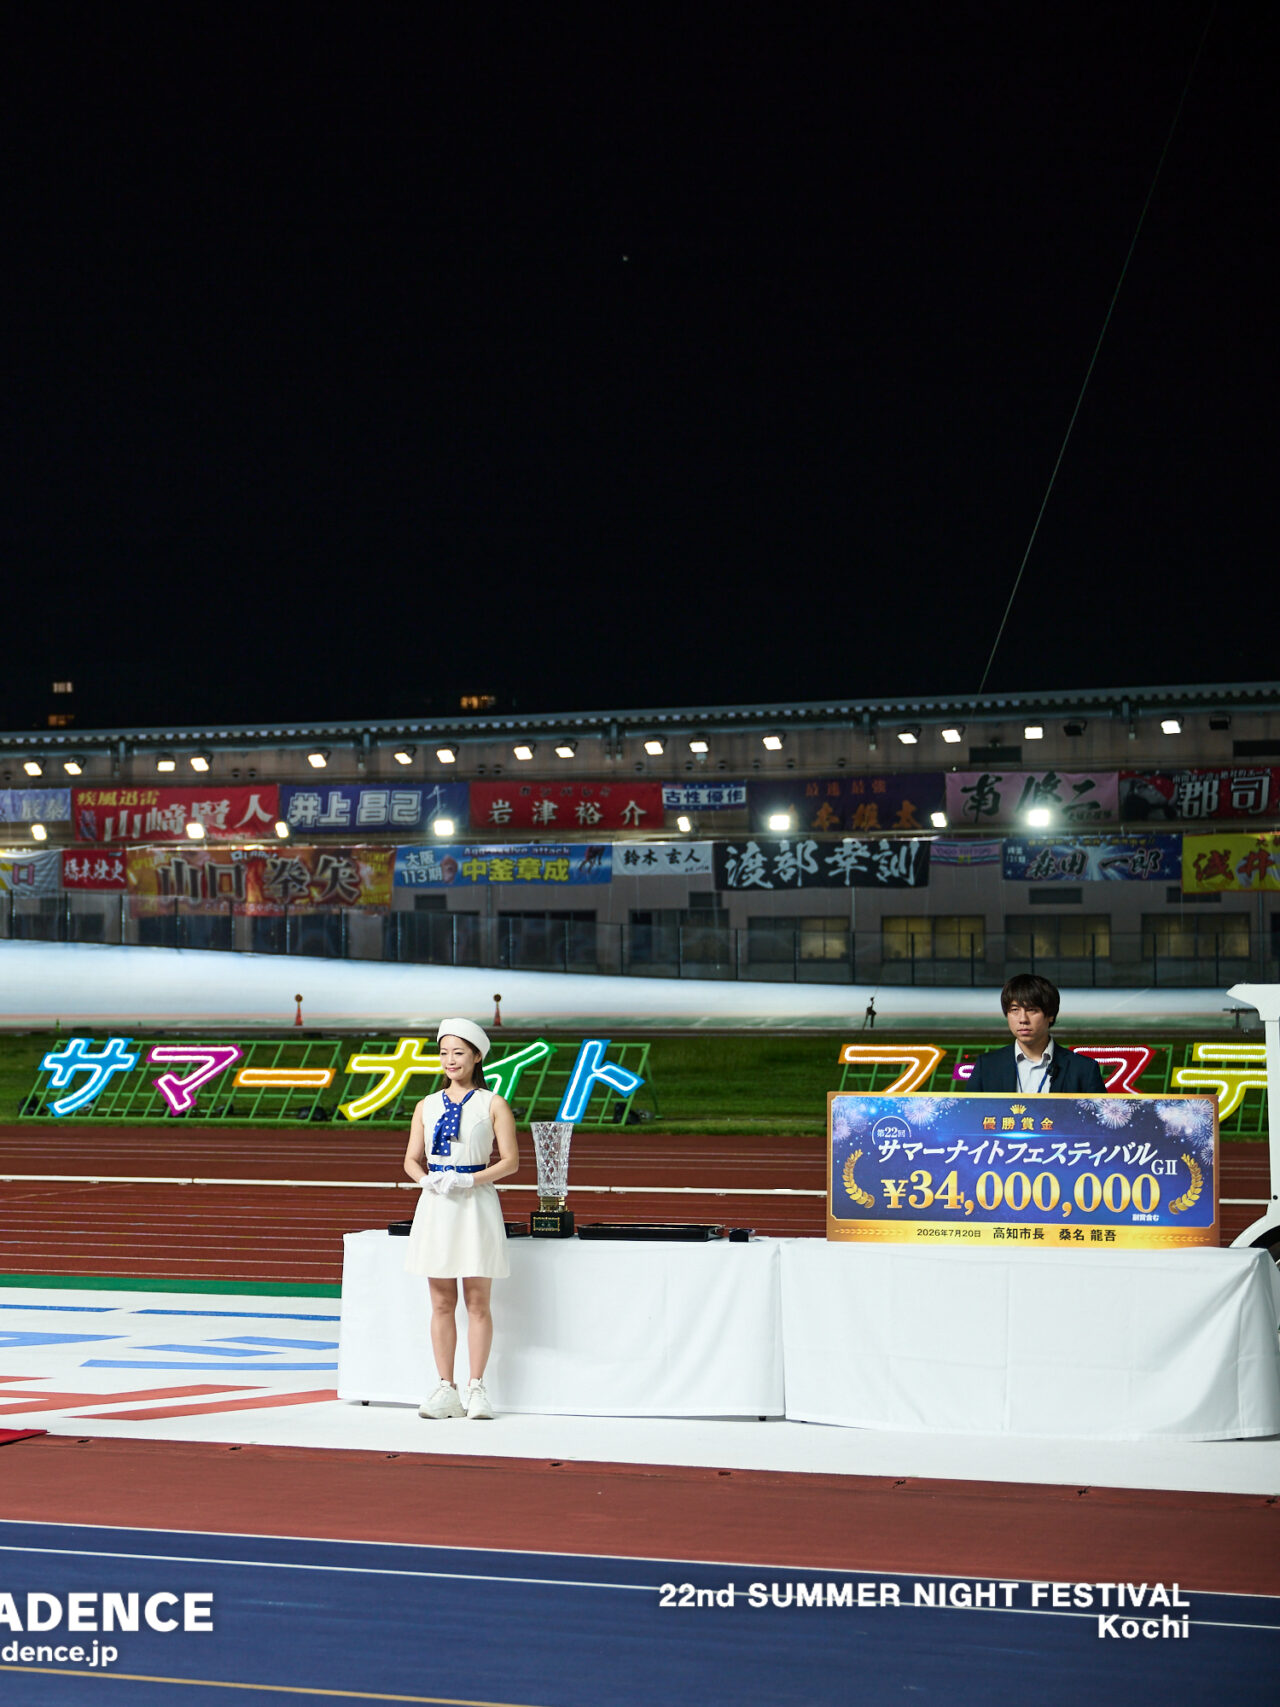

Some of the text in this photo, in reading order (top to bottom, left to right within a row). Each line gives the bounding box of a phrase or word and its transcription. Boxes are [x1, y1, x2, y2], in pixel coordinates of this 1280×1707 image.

[77, 789, 159, 806] 疾風迅雷
[287, 789, 422, 828] 井上昌己
[664, 789, 743, 804] 古性優作
[1177, 776, 1271, 818] 郡司
[488, 798, 647, 827] 岩津裕介
[405, 850, 434, 867] 大阪
[463, 845, 570, 856] Aggressive attack
[624, 848, 700, 866] 鈴木 玄人
[402, 866, 443, 884] 113期
[462, 857, 570, 882] 中釜章成
[724, 838, 920, 889] 渡部幸訓
[157, 854, 361, 905] 山口拳矢
[38, 1038, 645, 1122] サマーナイト
[838, 1043, 1268, 1122] フステ
[876, 1126, 907, 1139] 第22回
[983, 1116, 1054, 1131] 優勝賞金
[879, 1139, 1158, 1169] サマーナイトフェスティバル
[881, 1169, 1160, 1218] ¥34,000,000
[917, 1227, 1117, 1242] 2026年7月20日 高知市長 桑名 龍吾
